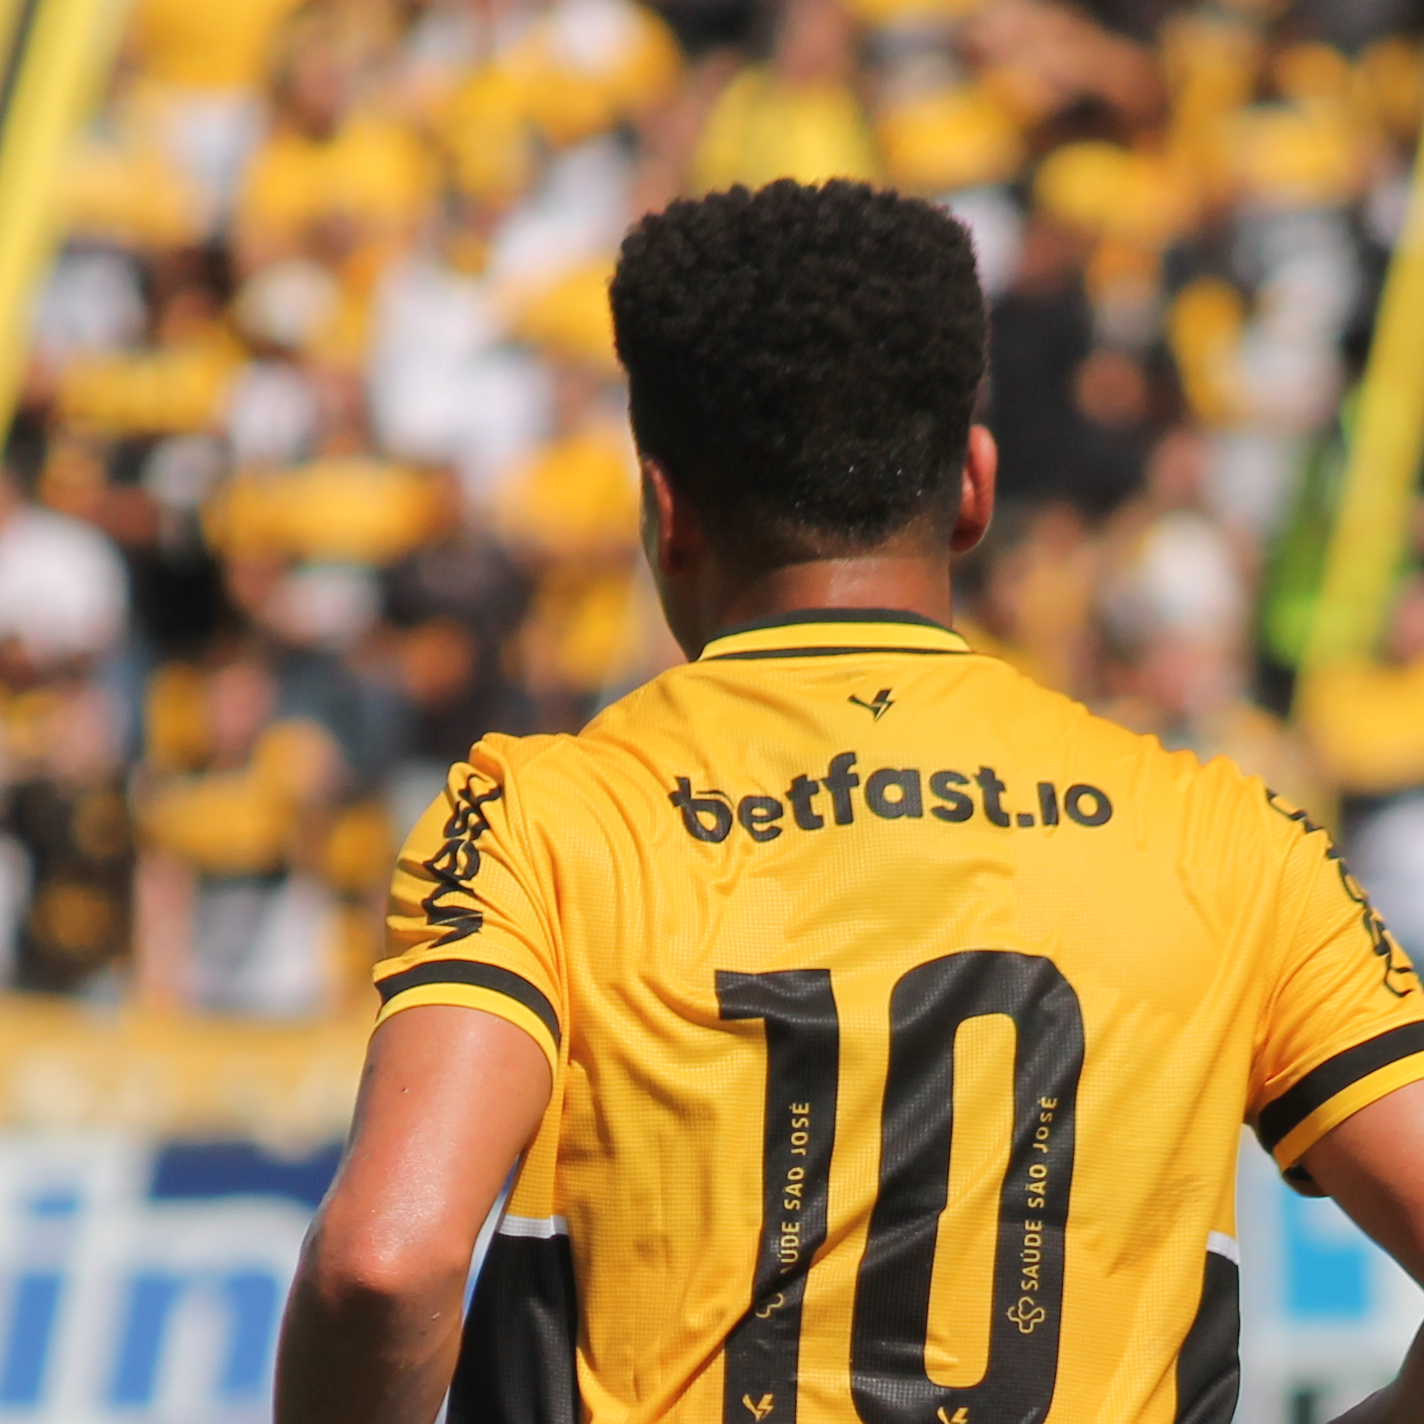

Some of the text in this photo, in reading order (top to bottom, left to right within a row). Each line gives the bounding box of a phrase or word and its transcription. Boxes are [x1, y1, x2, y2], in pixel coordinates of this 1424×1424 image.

[778, 1220, 802, 1275] ÚDE
[1020, 1095, 1059, 1292] SAÚDE SÃO JOSÉ
